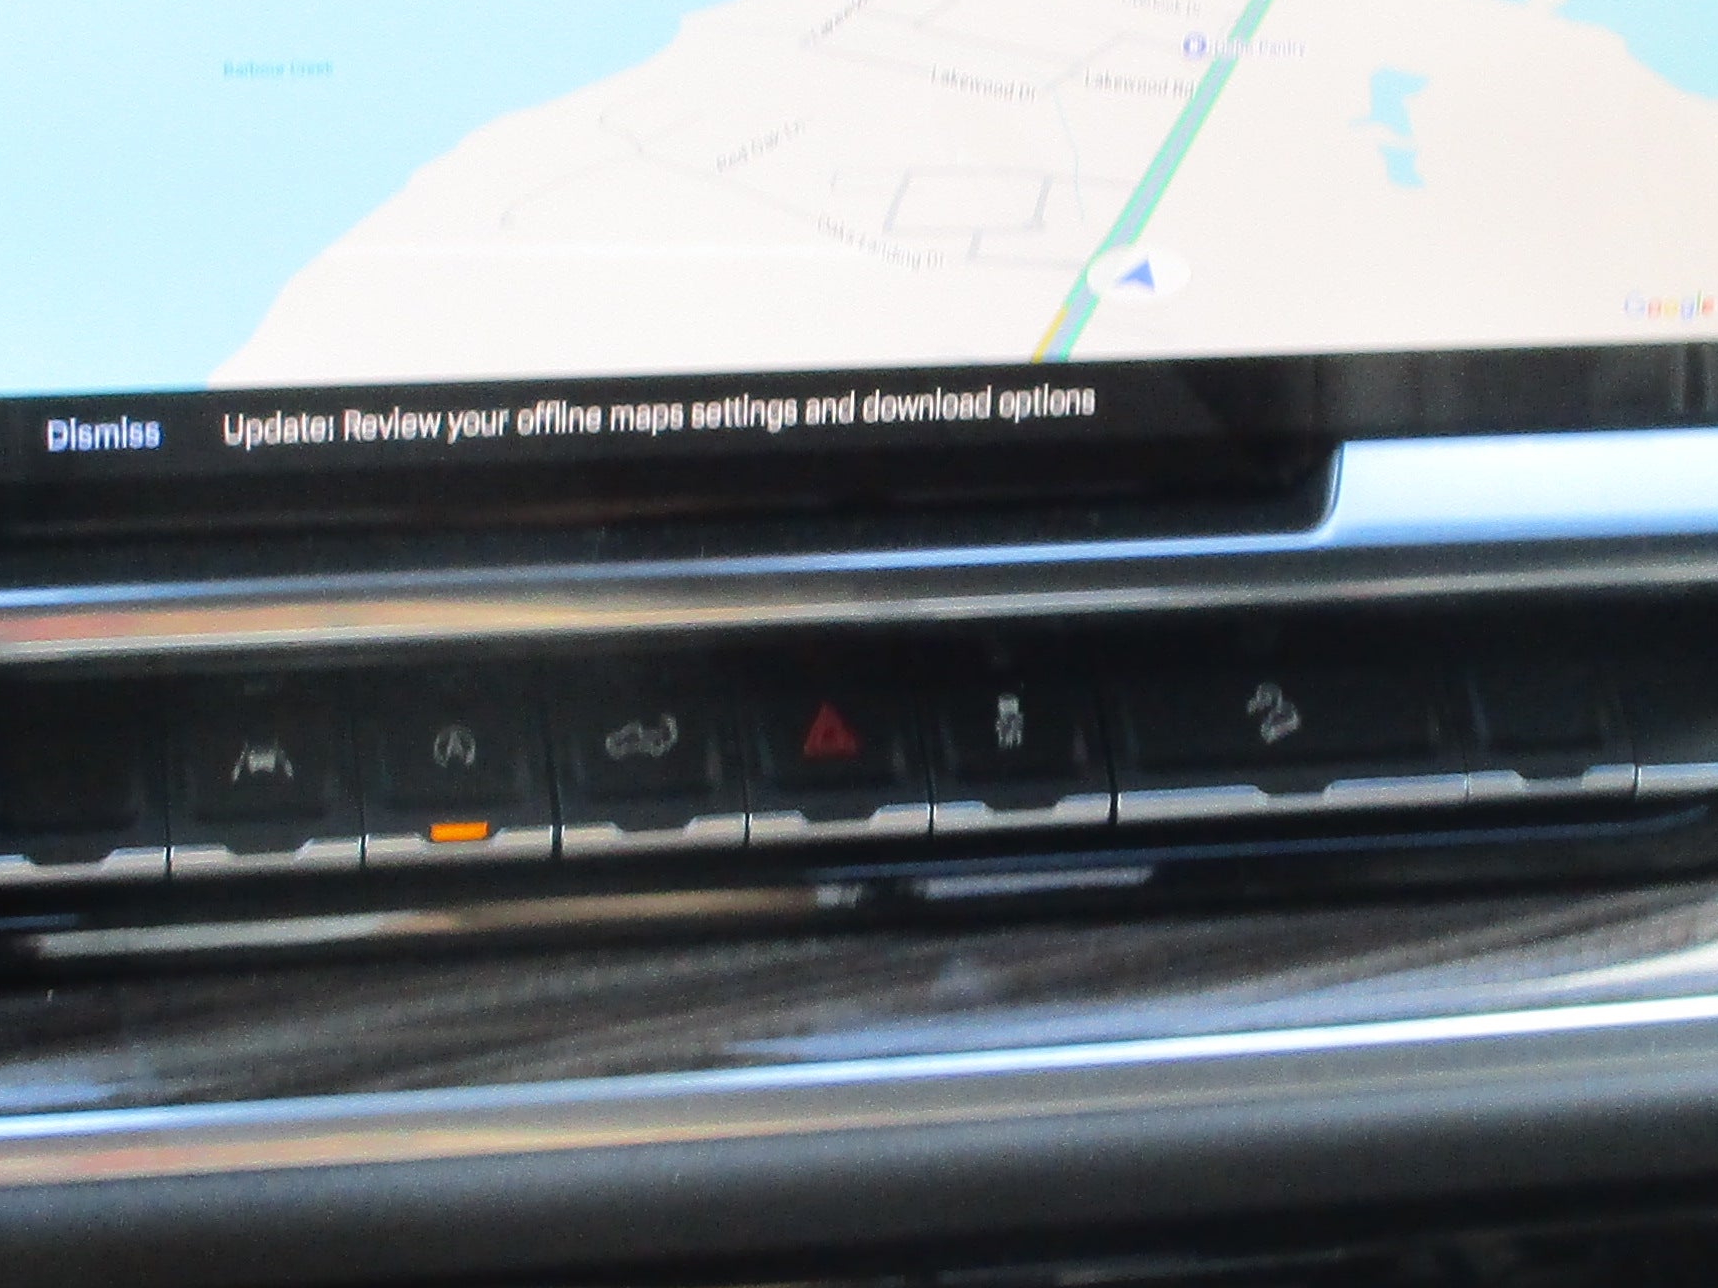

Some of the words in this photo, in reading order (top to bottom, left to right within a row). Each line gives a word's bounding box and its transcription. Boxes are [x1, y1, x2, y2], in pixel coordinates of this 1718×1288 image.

[930, 63, 1015, 101] Lakewood
[1084, 68, 1168, 97] Lakewood
[1623, 289, 1716, 321] Google
[47, 416, 161, 452] Dismiss
[223, 411, 334, 452] Update:
[344, 406, 439, 445] Review
[447, 408, 510, 445] your
[516, 399, 601, 436] offline
[609, 401, 684, 436] maps
[691, 393, 798, 433] settings
[804, 390, 855, 427] and
[862, 385, 991, 423] download
[999, 383, 1095, 423] options
